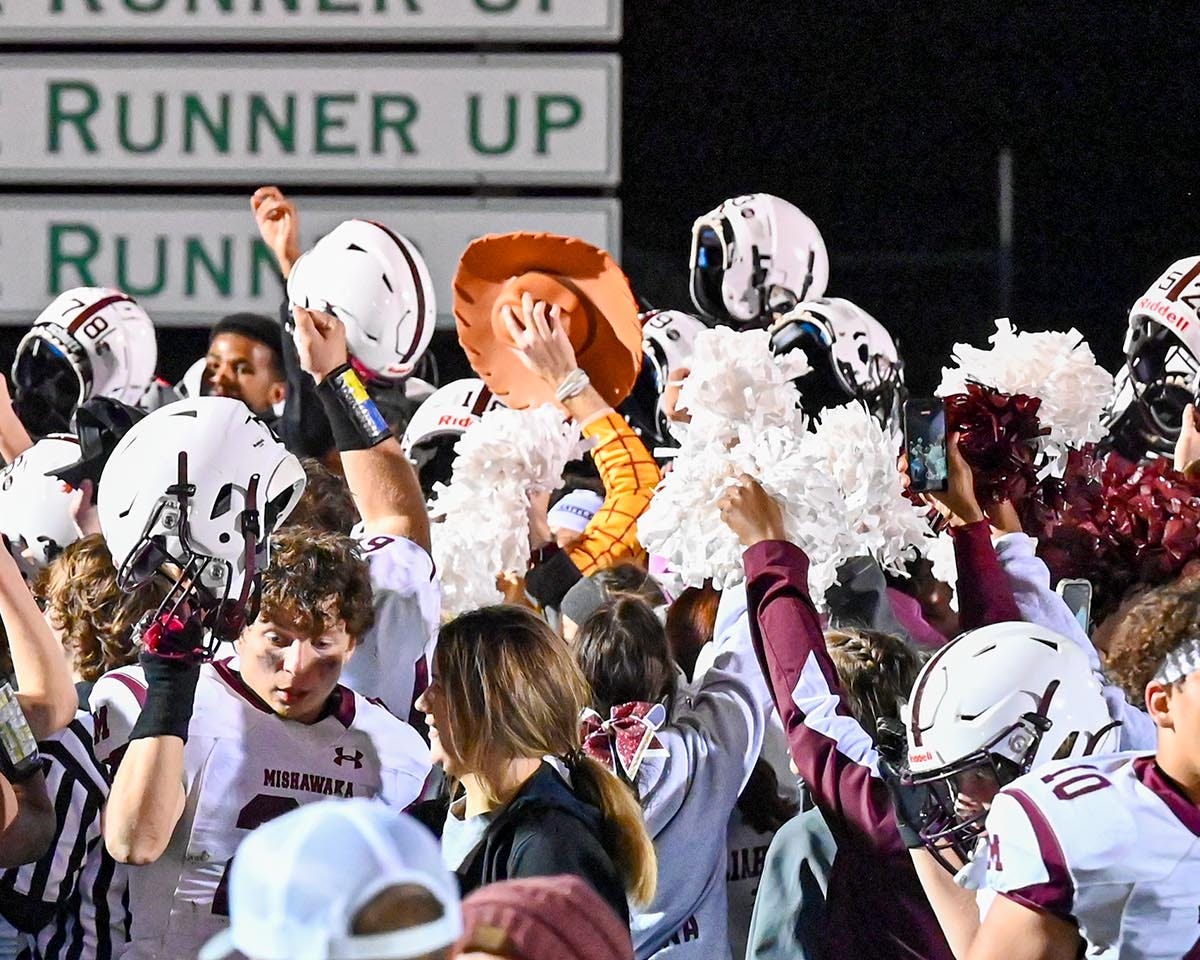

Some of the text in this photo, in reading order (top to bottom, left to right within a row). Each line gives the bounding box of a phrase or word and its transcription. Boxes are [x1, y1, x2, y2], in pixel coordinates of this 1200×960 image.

[46, 79, 421, 155] RUNNER
[467, 93, 585, 155] UP
[46, 222, 288, 298] RUNN
[263, 768, 354, 799] MISHAWAKA
